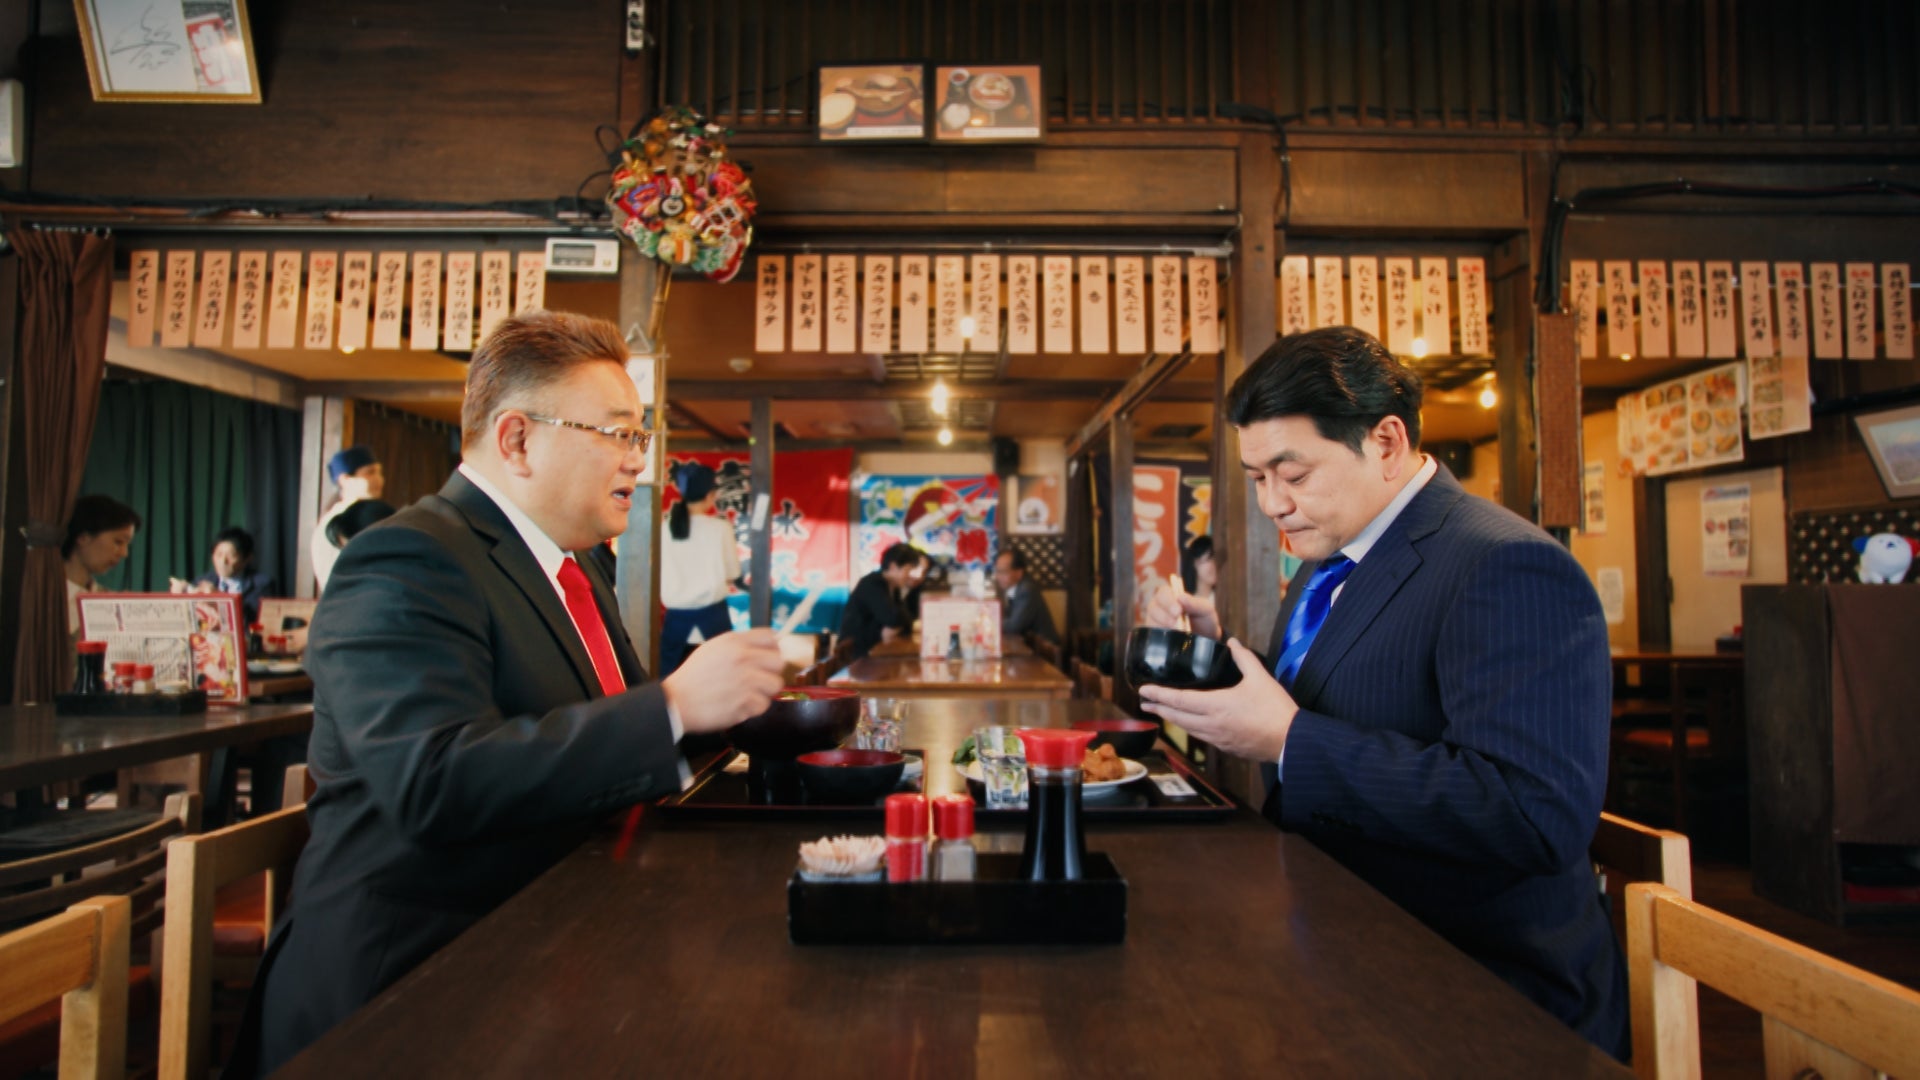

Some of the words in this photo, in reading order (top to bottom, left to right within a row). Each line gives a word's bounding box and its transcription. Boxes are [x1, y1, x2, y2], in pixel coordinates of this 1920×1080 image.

[763, 263, 779, 328] 海鮮サラダ
[799, 261, 817, 330] 中トロ刺身
[1194, 263, 1212, 326] イカリング
[1391, 265, 1407, 330] 海鮮サラダ
